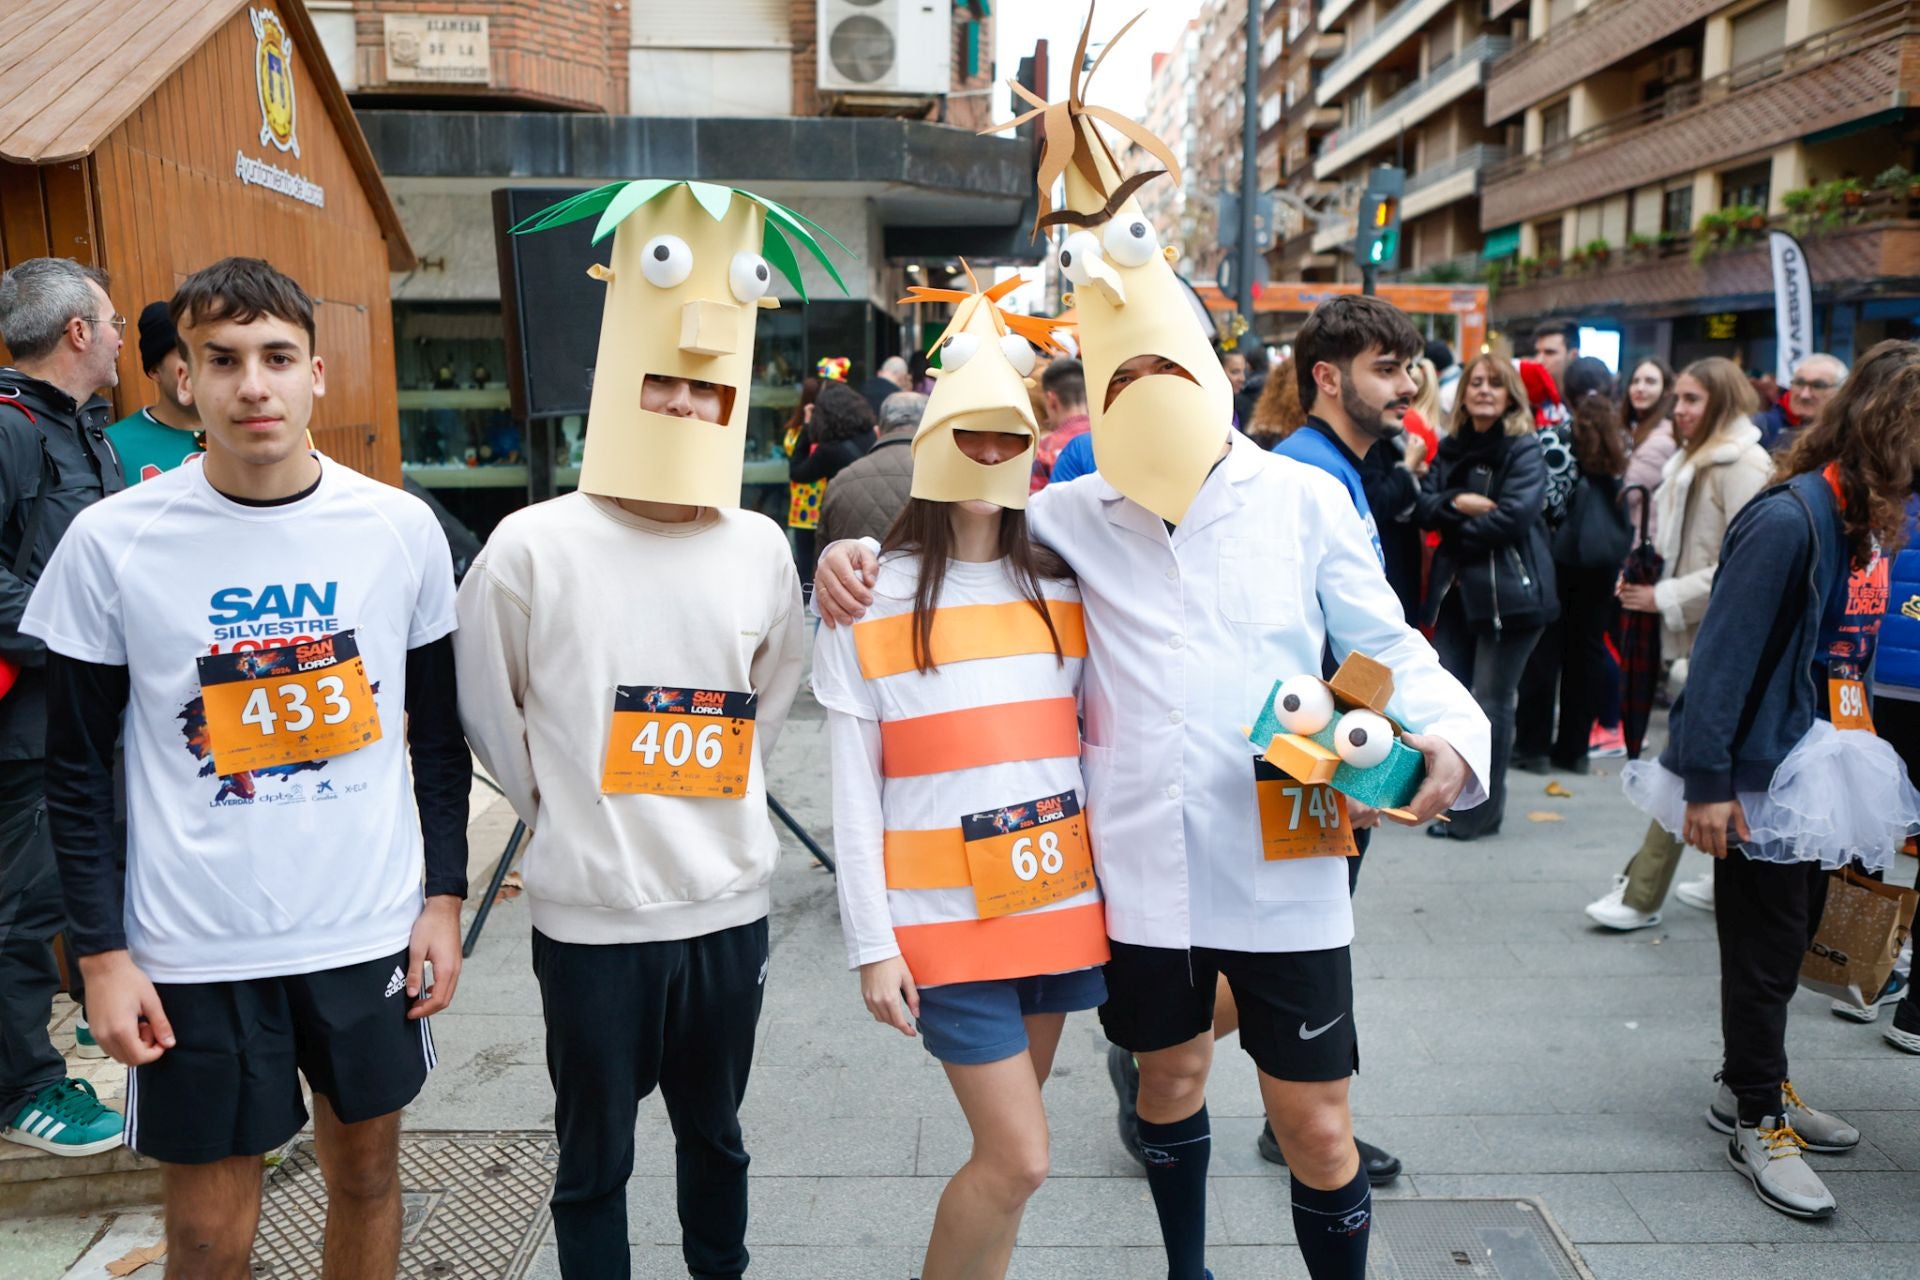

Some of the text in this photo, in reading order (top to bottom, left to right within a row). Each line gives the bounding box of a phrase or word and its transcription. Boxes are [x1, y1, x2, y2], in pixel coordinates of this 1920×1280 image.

[208, 582, 338, 626] SAN
[214, 619, 339, 641] SILVESTRE
[295, 639, 334, 658] SAN
[298, 656, 338, 672] LORCA
[241, 675, 351, 736] 433
[692, 691, 727, 704] SAN
[690, 706, 723, 715] LORCA
[631, 721, 723, 768] 406
[210, 799, 254, 808] LA VERDAD
[1036, 797, 1062, 813] SAN
[1281, 786, 1341, 832] 749
[1011, 830, 1064, 881] 68
[384, 975, 407, 998] adida
